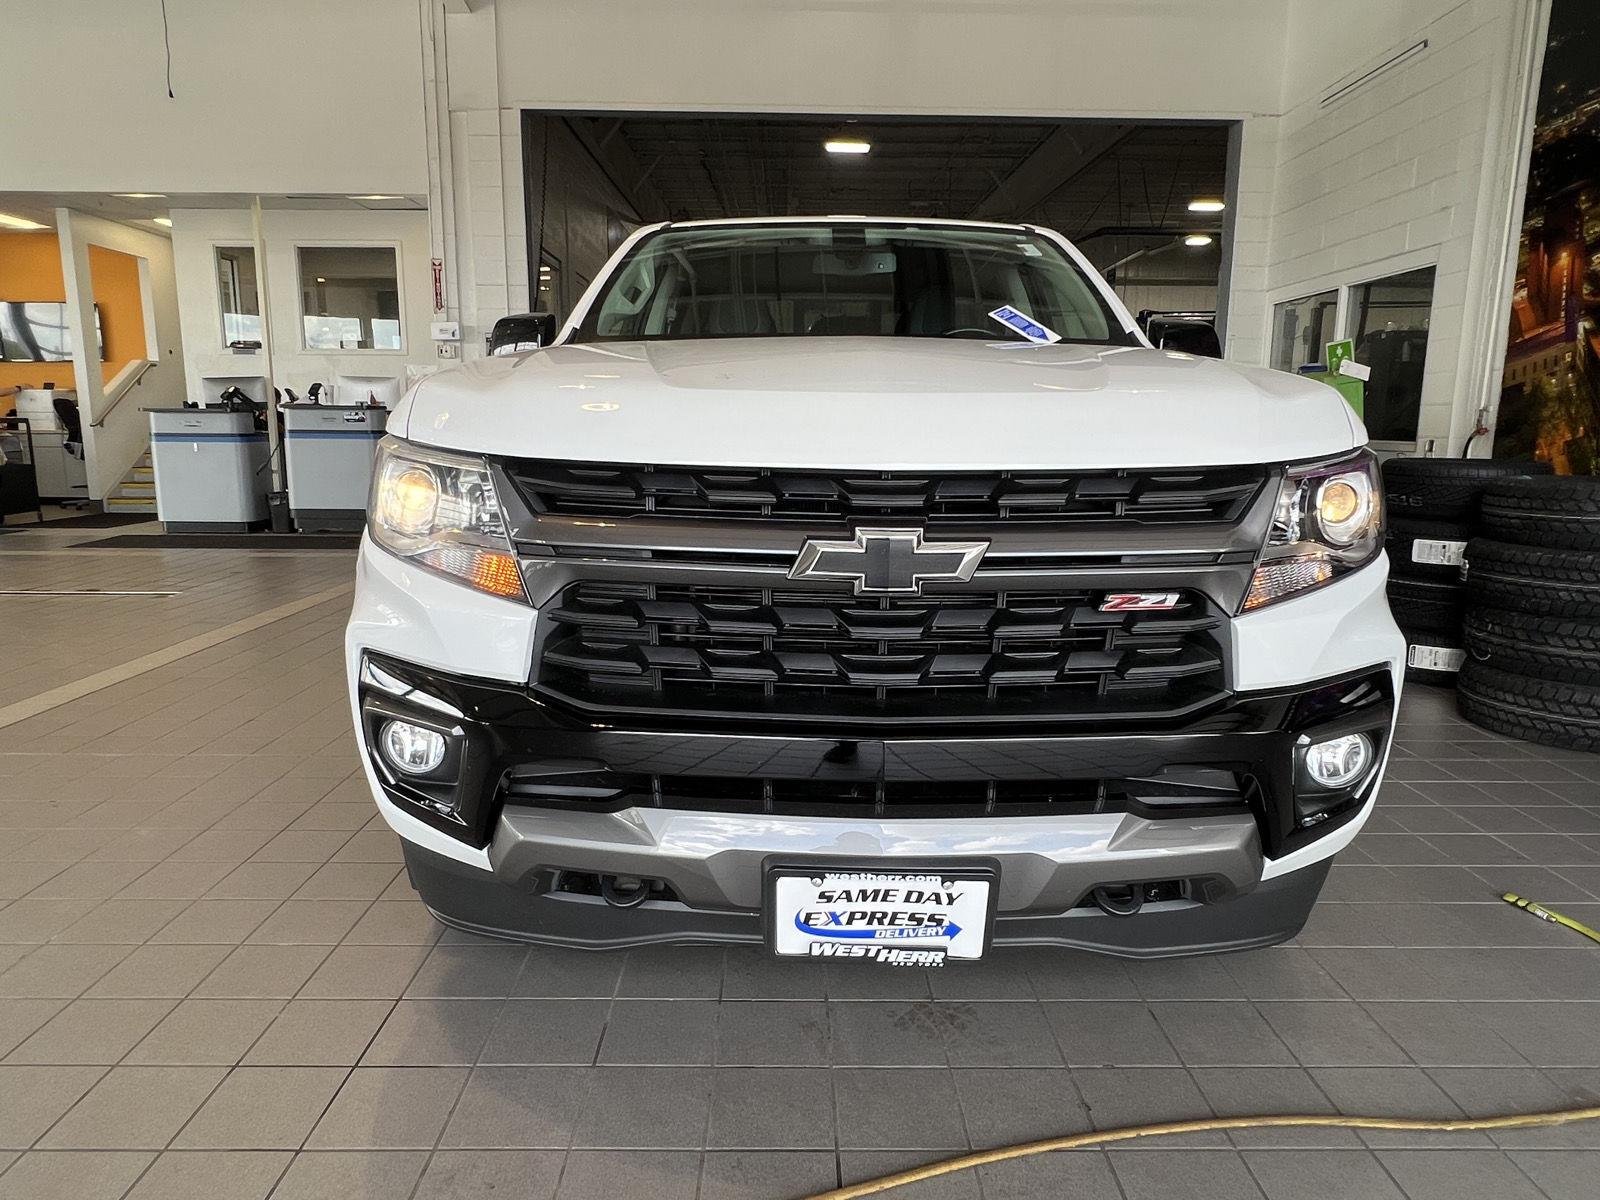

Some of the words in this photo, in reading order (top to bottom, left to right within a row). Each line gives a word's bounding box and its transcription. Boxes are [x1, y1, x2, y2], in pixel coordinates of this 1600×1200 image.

[1099, 593, 1180, 611] Z71
[816, 889, 899, 904] SAME
[903, 890, 963, 905] DAY
[803, 911, 948, 926] EXPRESS
[874, 926, 947, 939] DELIVERY
